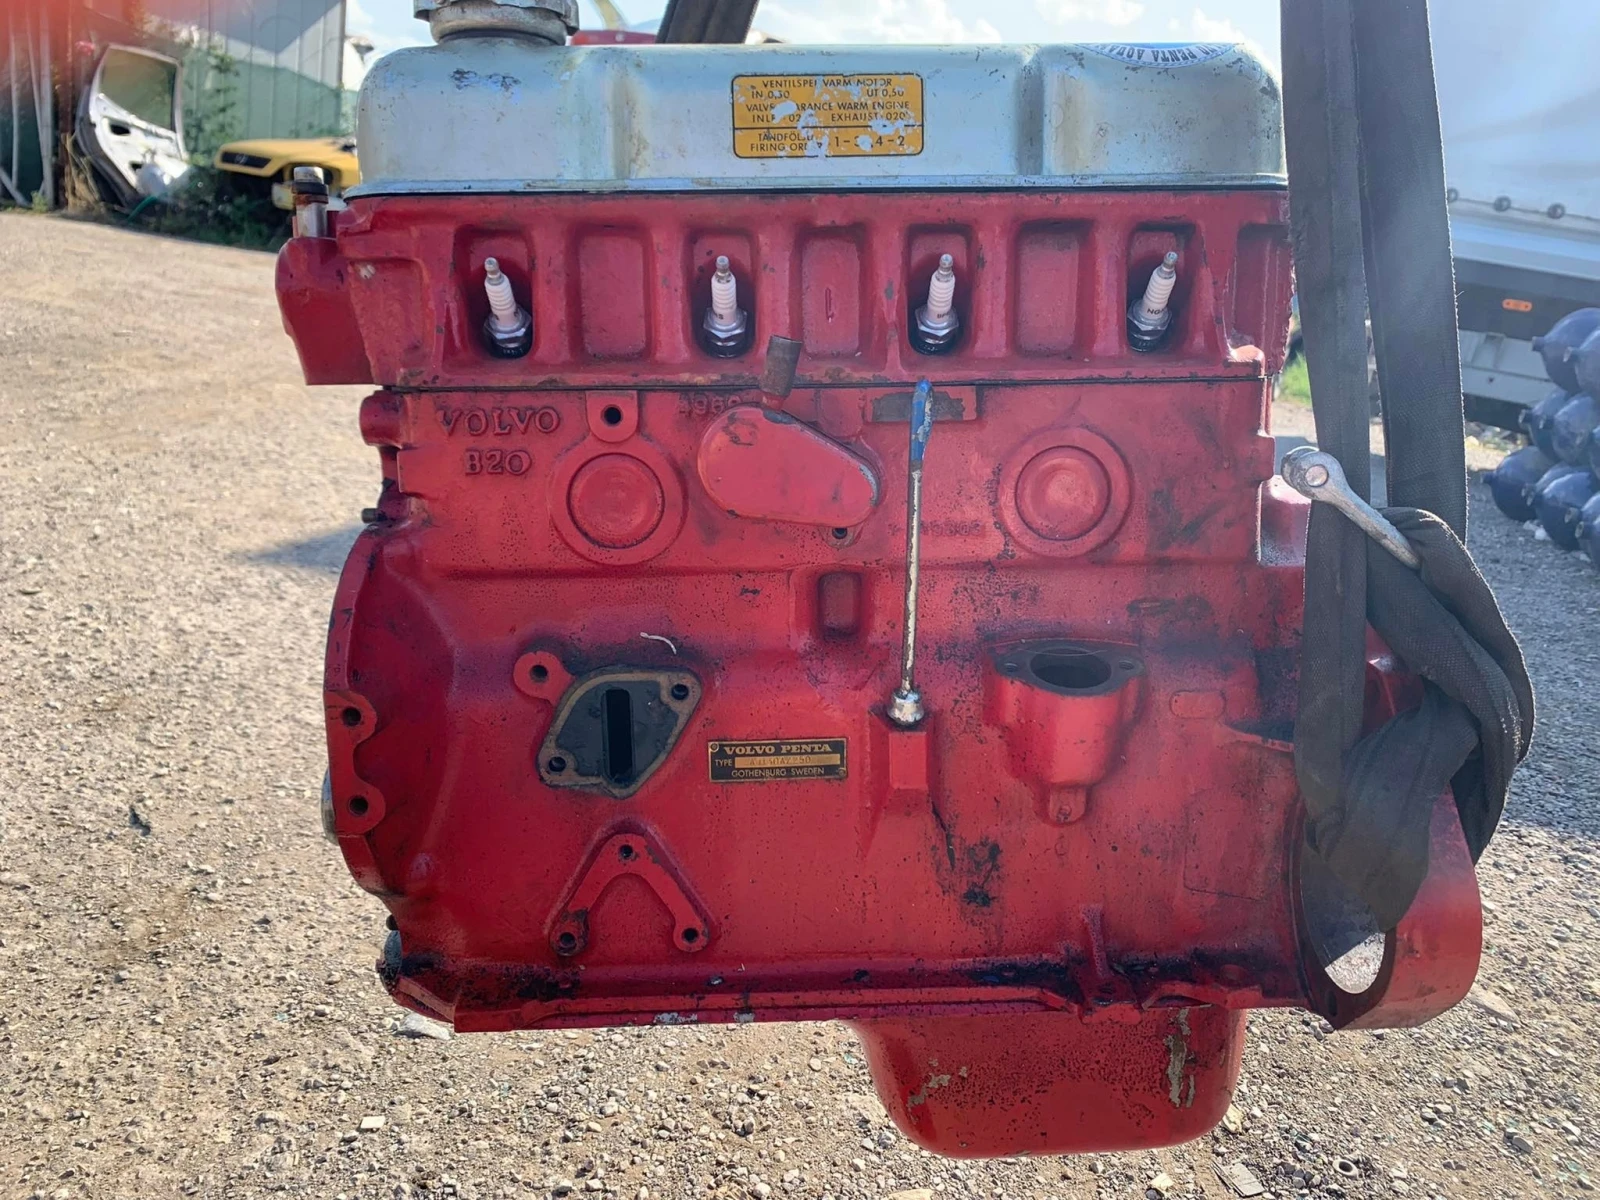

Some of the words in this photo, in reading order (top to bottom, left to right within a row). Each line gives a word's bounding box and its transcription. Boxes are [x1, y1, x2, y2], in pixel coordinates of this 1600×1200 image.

[1153, 48, 1197, 62] PENTA
[822, 78, 851, 88] VARM
[752, 90, 763, 99] IN
[866, 89, 879, 97] UT
[837, 102, 868, 111] WARM
[872, 101, 910, 110] ENGINE
[831, 112, 878, 122] EXHAUST
[751, 142, 785, 151] FIRING
[436, 406, 560, 437] VOLVO
[464, 448, 532, 476] B20
[724, 745, 776, 755] VOLVO
[781, 743, 832, 753] PENTA
[715, 758, 733, 767] TYPE
[731, 768, 787, 778] GOTHENBURG
[791, 767, 824, 776] SWEDEN
